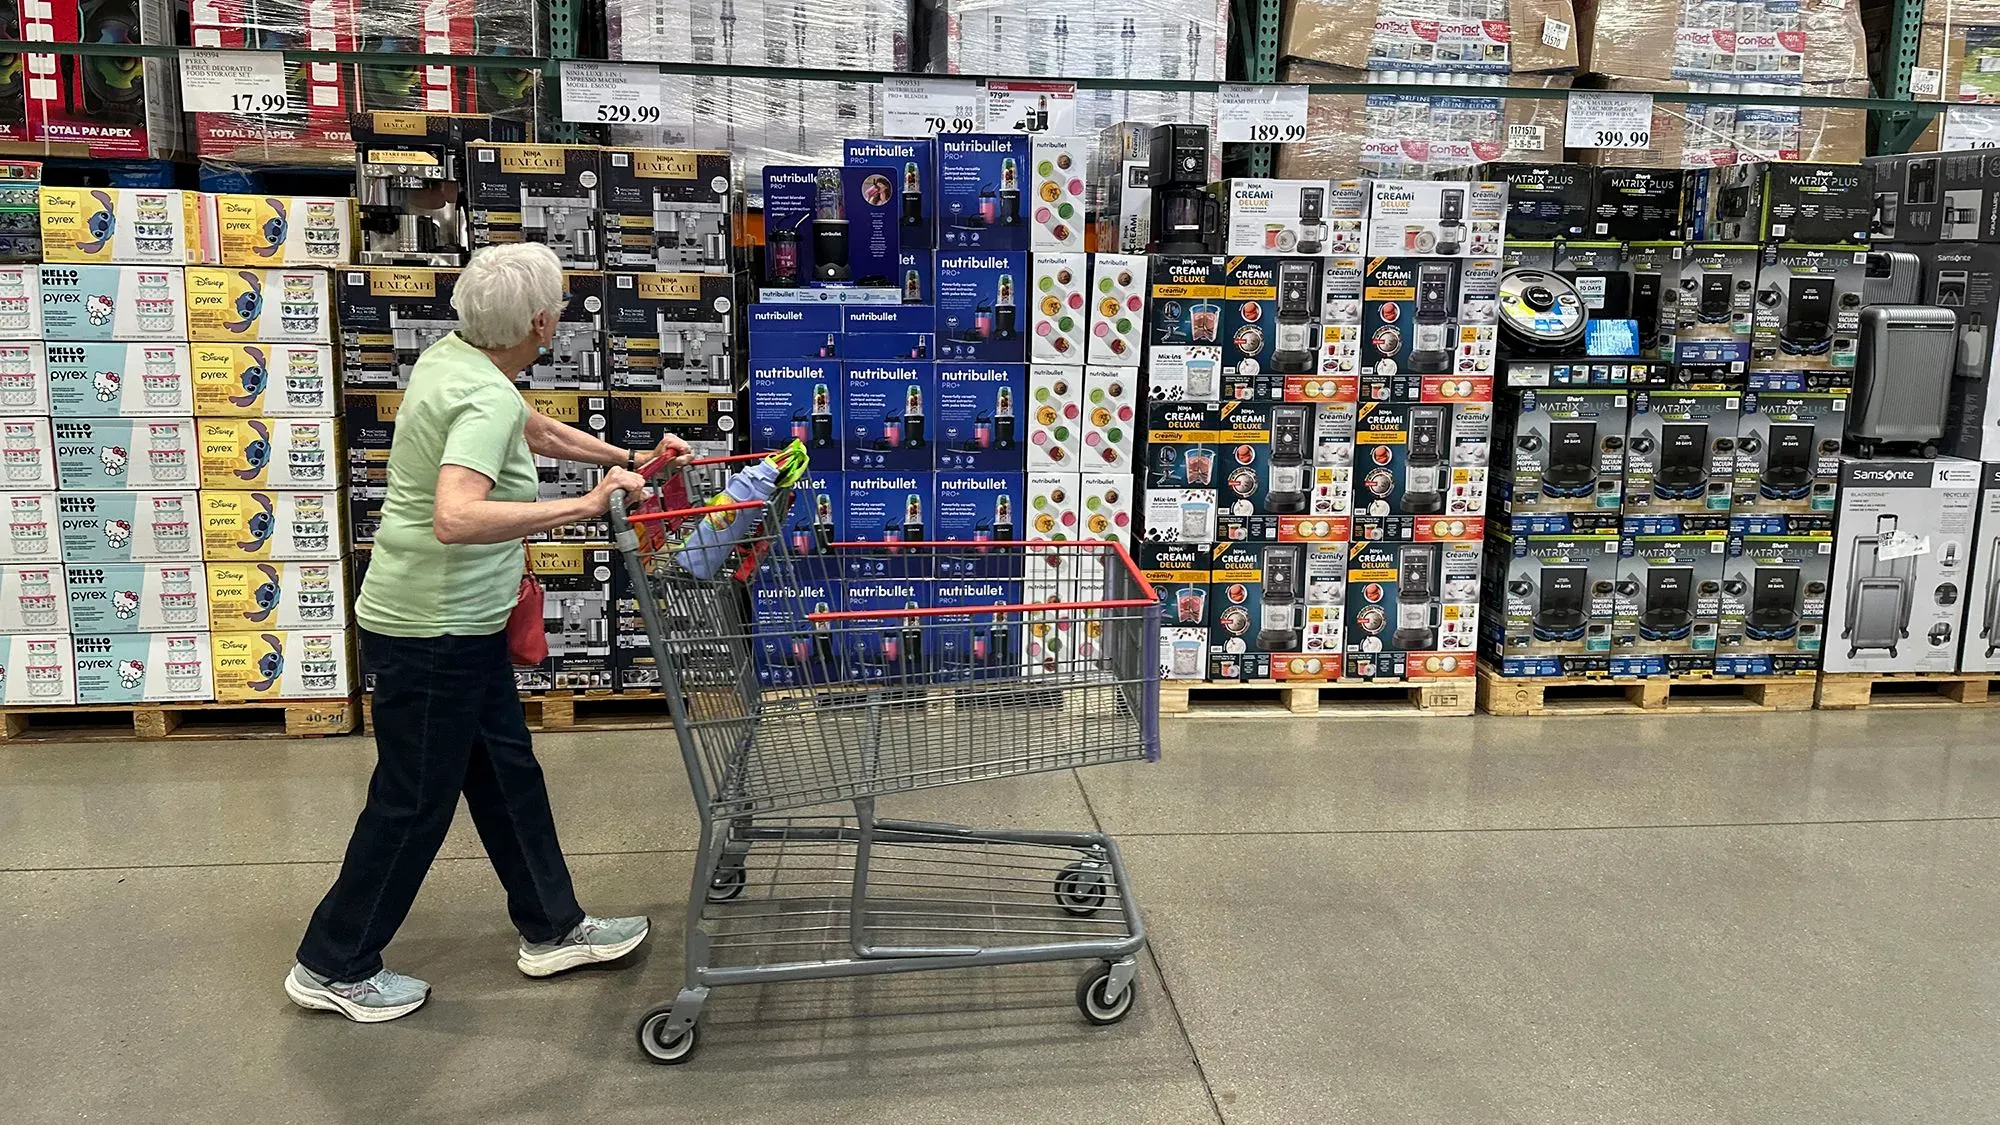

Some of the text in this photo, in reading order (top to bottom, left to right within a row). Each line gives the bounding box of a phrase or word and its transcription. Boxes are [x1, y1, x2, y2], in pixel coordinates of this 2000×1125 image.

[231, 94, 285, 112] 17.99
[597, 105, 660, 123] 529.99
[42, 125, 80, 135] TOTAL
[99, 126, 132, 137] APEX
[924, 117, 973, 134] 79.99
[209, 129, 246, 138] TOTAL
[266, 130, 295, 140] APEX
[323, 131, 351, 140] TOTA
[1249, 125, 1305, 141] 189.99
[1594, 131, 1649, 147] 399.99
[944, 140, 1013, 154] nutribullet.
[523, 150, 542, 158] NINJA
[503, 157, 563, 167] LUXE CAFÉ
[637, 162, 696, 172] LUXE CAFÉ
[1507, 175, 1573, 186] MATRIX PLUS
[1612, 178, 1674, 189] MATRIX PLUS
[1790, 176, 1859, 186] MATRIX PLUS
[480, 182, 486, 191] 3
[1235, 190, 1274, 200] CREAMi
[1332, 189, 1364, 198] Creamify
[1377, 192, 1414, 201] CREAMi
[1472, 191, 1503, 199] Creamify
[43, 195, 76, 208] Disney
[225, 201, 252, 214] Disney
[941, 257, 1009, 269] nutribullet.
[1780, 257, 1849, 267] MATRIX PLUS
[1168, 266, 1210, 275] CREAMi
[1235, 270, 1272, 279] CREAMi
[1327, 268, 1362, 277] Creamify
[1375, 270, 1411, 280] CREAMi
[1464, 269, 1498, 277] Creamify
[192, 276, 224, 289] Disney
[373, 279, 432, 290] LUXE CAFÉ
[1172, 275, 1206, 283] DELUXE
[43, 293, 80, 304] pyrex
[755, 311, 803, 321] nutribullet
[850, 312, 897, 322] nutribullet
[49, 355, 85, 363] KITTY
[197, 352, 230, 364] Disney
[50, 370, 88, 381] pyrex
[755, 367, 824, 380] nutribullet.
[850, 368, 918, 381] nutribullet.
[941, 369, 1009, 381] nutribullet.
[548, 404, 577, 415] CAFÉ
[56, 431, 92, 439] KITTY
[203, 425, 235, 437] Disney
[59, 445, 95, 456] pyrex
[1853, 470, 1914, 481] Samsonite
[62, 518, 99, 530] pyrex
[71, 590, 107, 601] pyrex
[78, 659, 113, 670] pyrex
